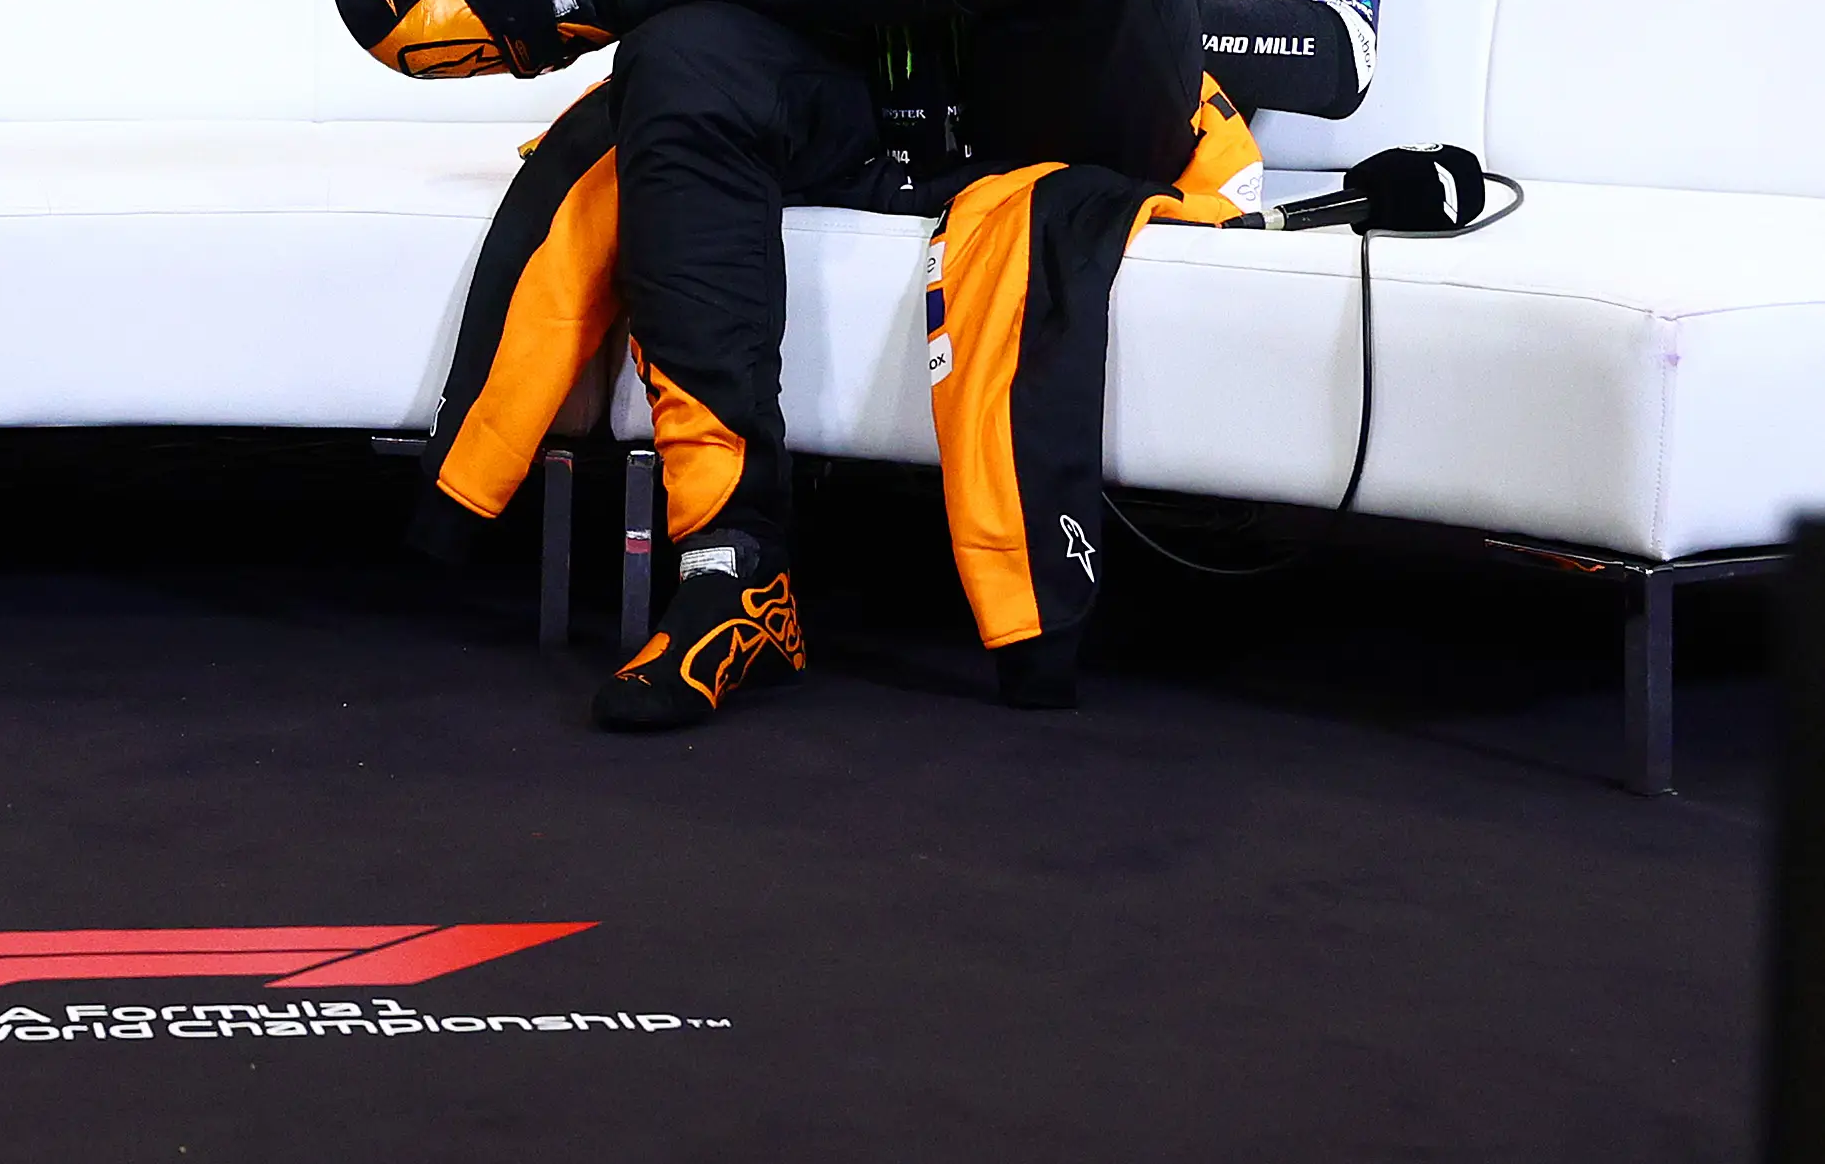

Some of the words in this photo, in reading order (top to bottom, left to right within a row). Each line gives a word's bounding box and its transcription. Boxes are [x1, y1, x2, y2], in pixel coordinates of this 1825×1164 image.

[1253, 36, 1315, 55] MILLE
[65, 1000, 363, 1023] Formula
[371, 999, 417, 1016] 1
